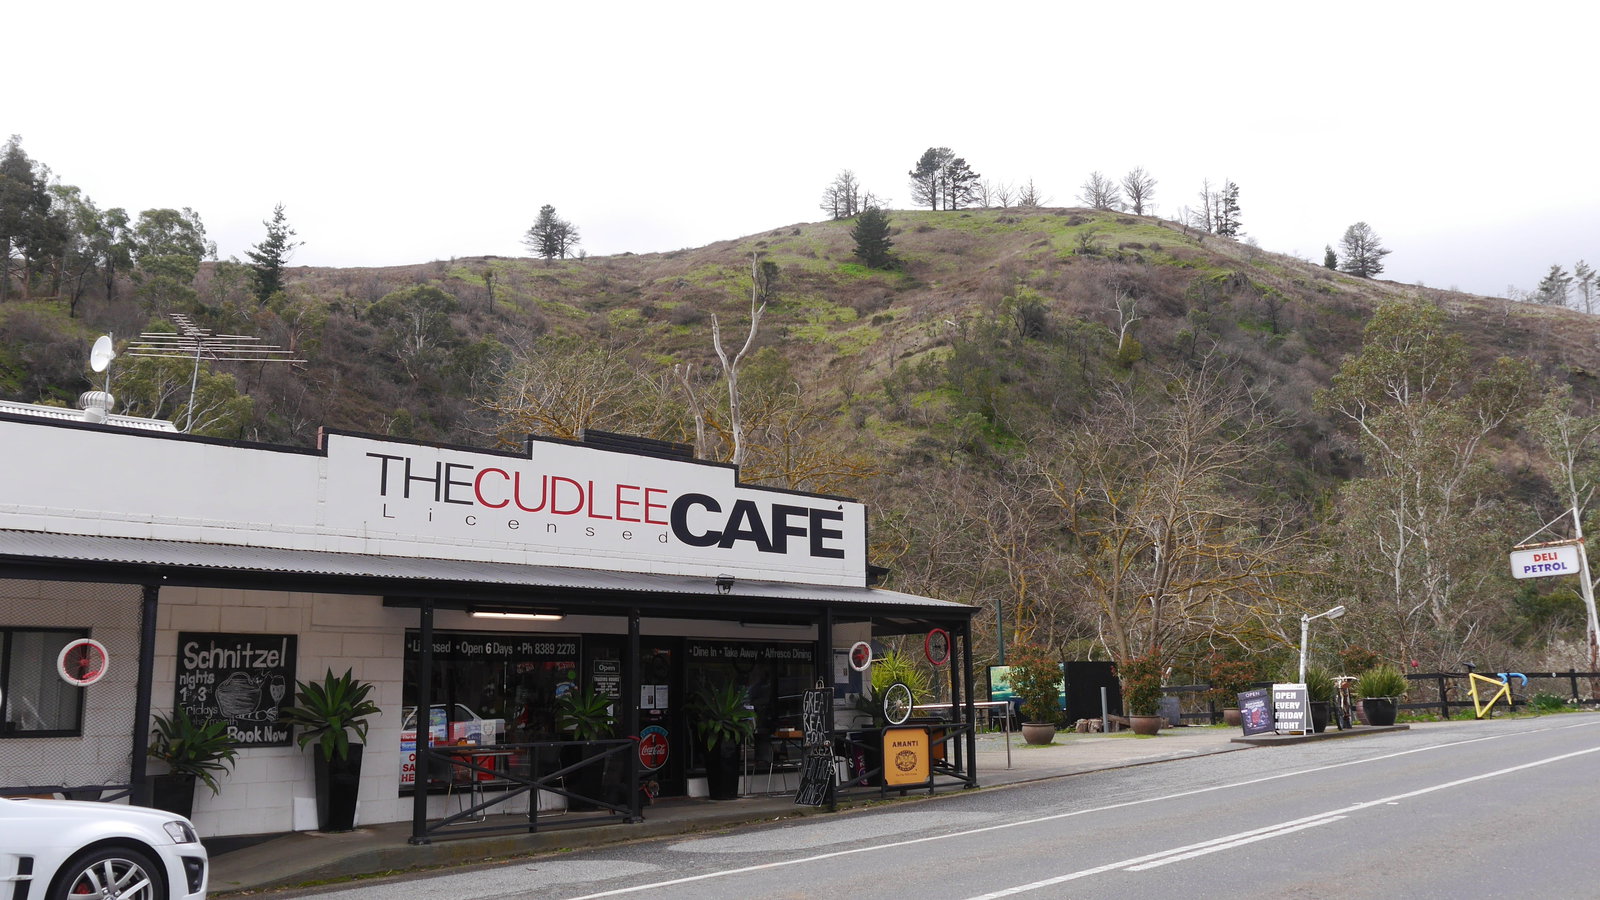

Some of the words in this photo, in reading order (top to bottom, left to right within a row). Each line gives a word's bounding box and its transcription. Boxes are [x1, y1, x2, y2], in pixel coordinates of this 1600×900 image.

[383, 503, 668, 544] Licensed
[1533, 552, 1558, 562] DELI
[1524, 562, 1568, 573] PETROL
[184, 638, 287, 670] Schnitzel
[413, 640, 451, 653] Linsed
[461, 641, 484, 654] Open
[485, 642, 492, 654] 6
[493, 642, 513, 656] Days
[522, 642, 533, 655] Ph
[534, 643, 555, 655] 8389
[556, 643, 576, 655] 2278
[693, 646, 709, 657] Dine
[710, 646, 717, 657] In
[723, 646, 738, 658] Take
[740, 647, 759, 660] Away
[765, 647, 791, 659] Alfresco
[792, 648, 812, 661] Dining
[598, 664, 616, 672] Open
[180, 670, 215, 689] nights
[803, 691, 831, 714] GREAT
[1275, 692, 1296, 700] OPEN
[1275, 701, 1300, 710] EVERY
[1275, 711, 1304, 720] FRIDAY
[803, 713, 829, 734] REAL
[1275, 721, 1300, 730] NIGHT
[227, 726, 262, 743] Book
[264, 726, 288, 742] Now
[892, 740, 919, 748] AMANTI
